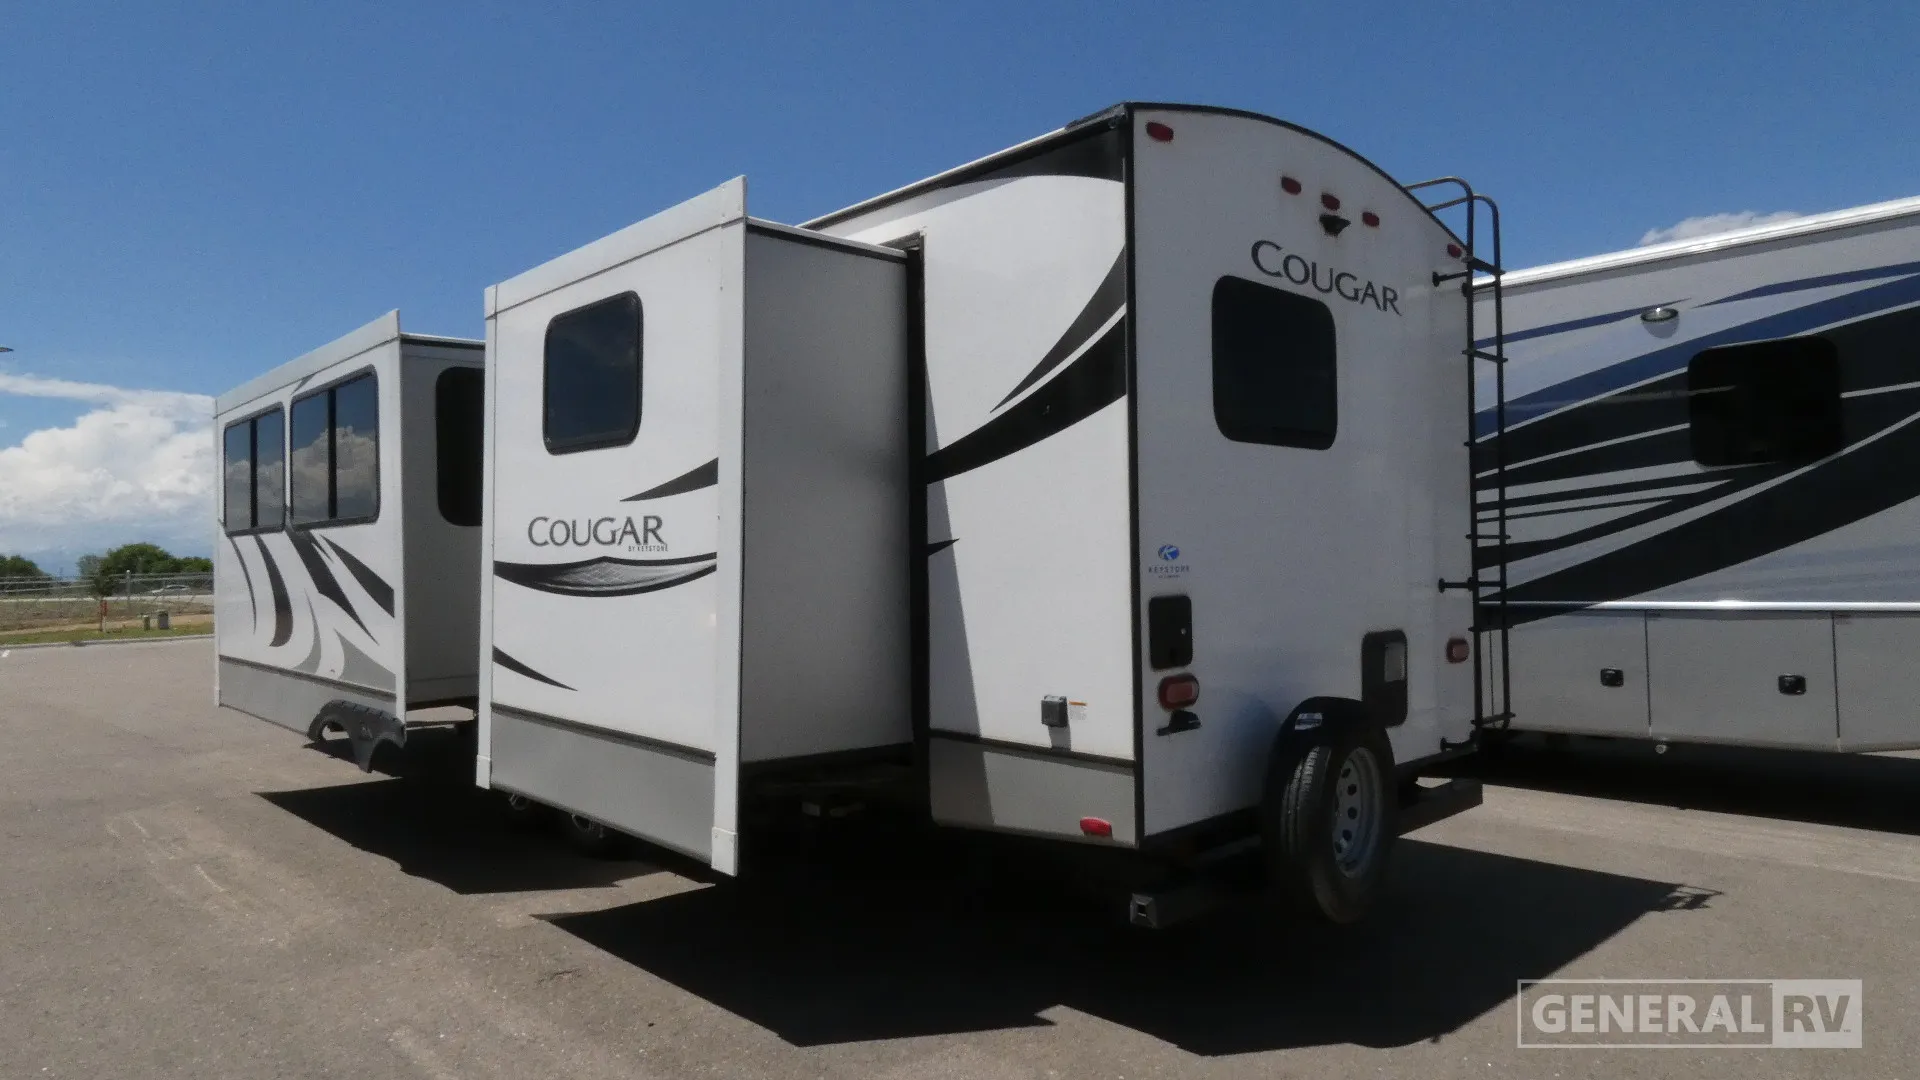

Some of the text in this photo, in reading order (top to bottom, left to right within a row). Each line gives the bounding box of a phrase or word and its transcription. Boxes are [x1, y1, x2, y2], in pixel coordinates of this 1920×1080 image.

[1251, 240, 1402, 316] COUGAR
[528, 515, 667, 546] COUGAR
[637, 544, 669, 552] KEYSTONE
